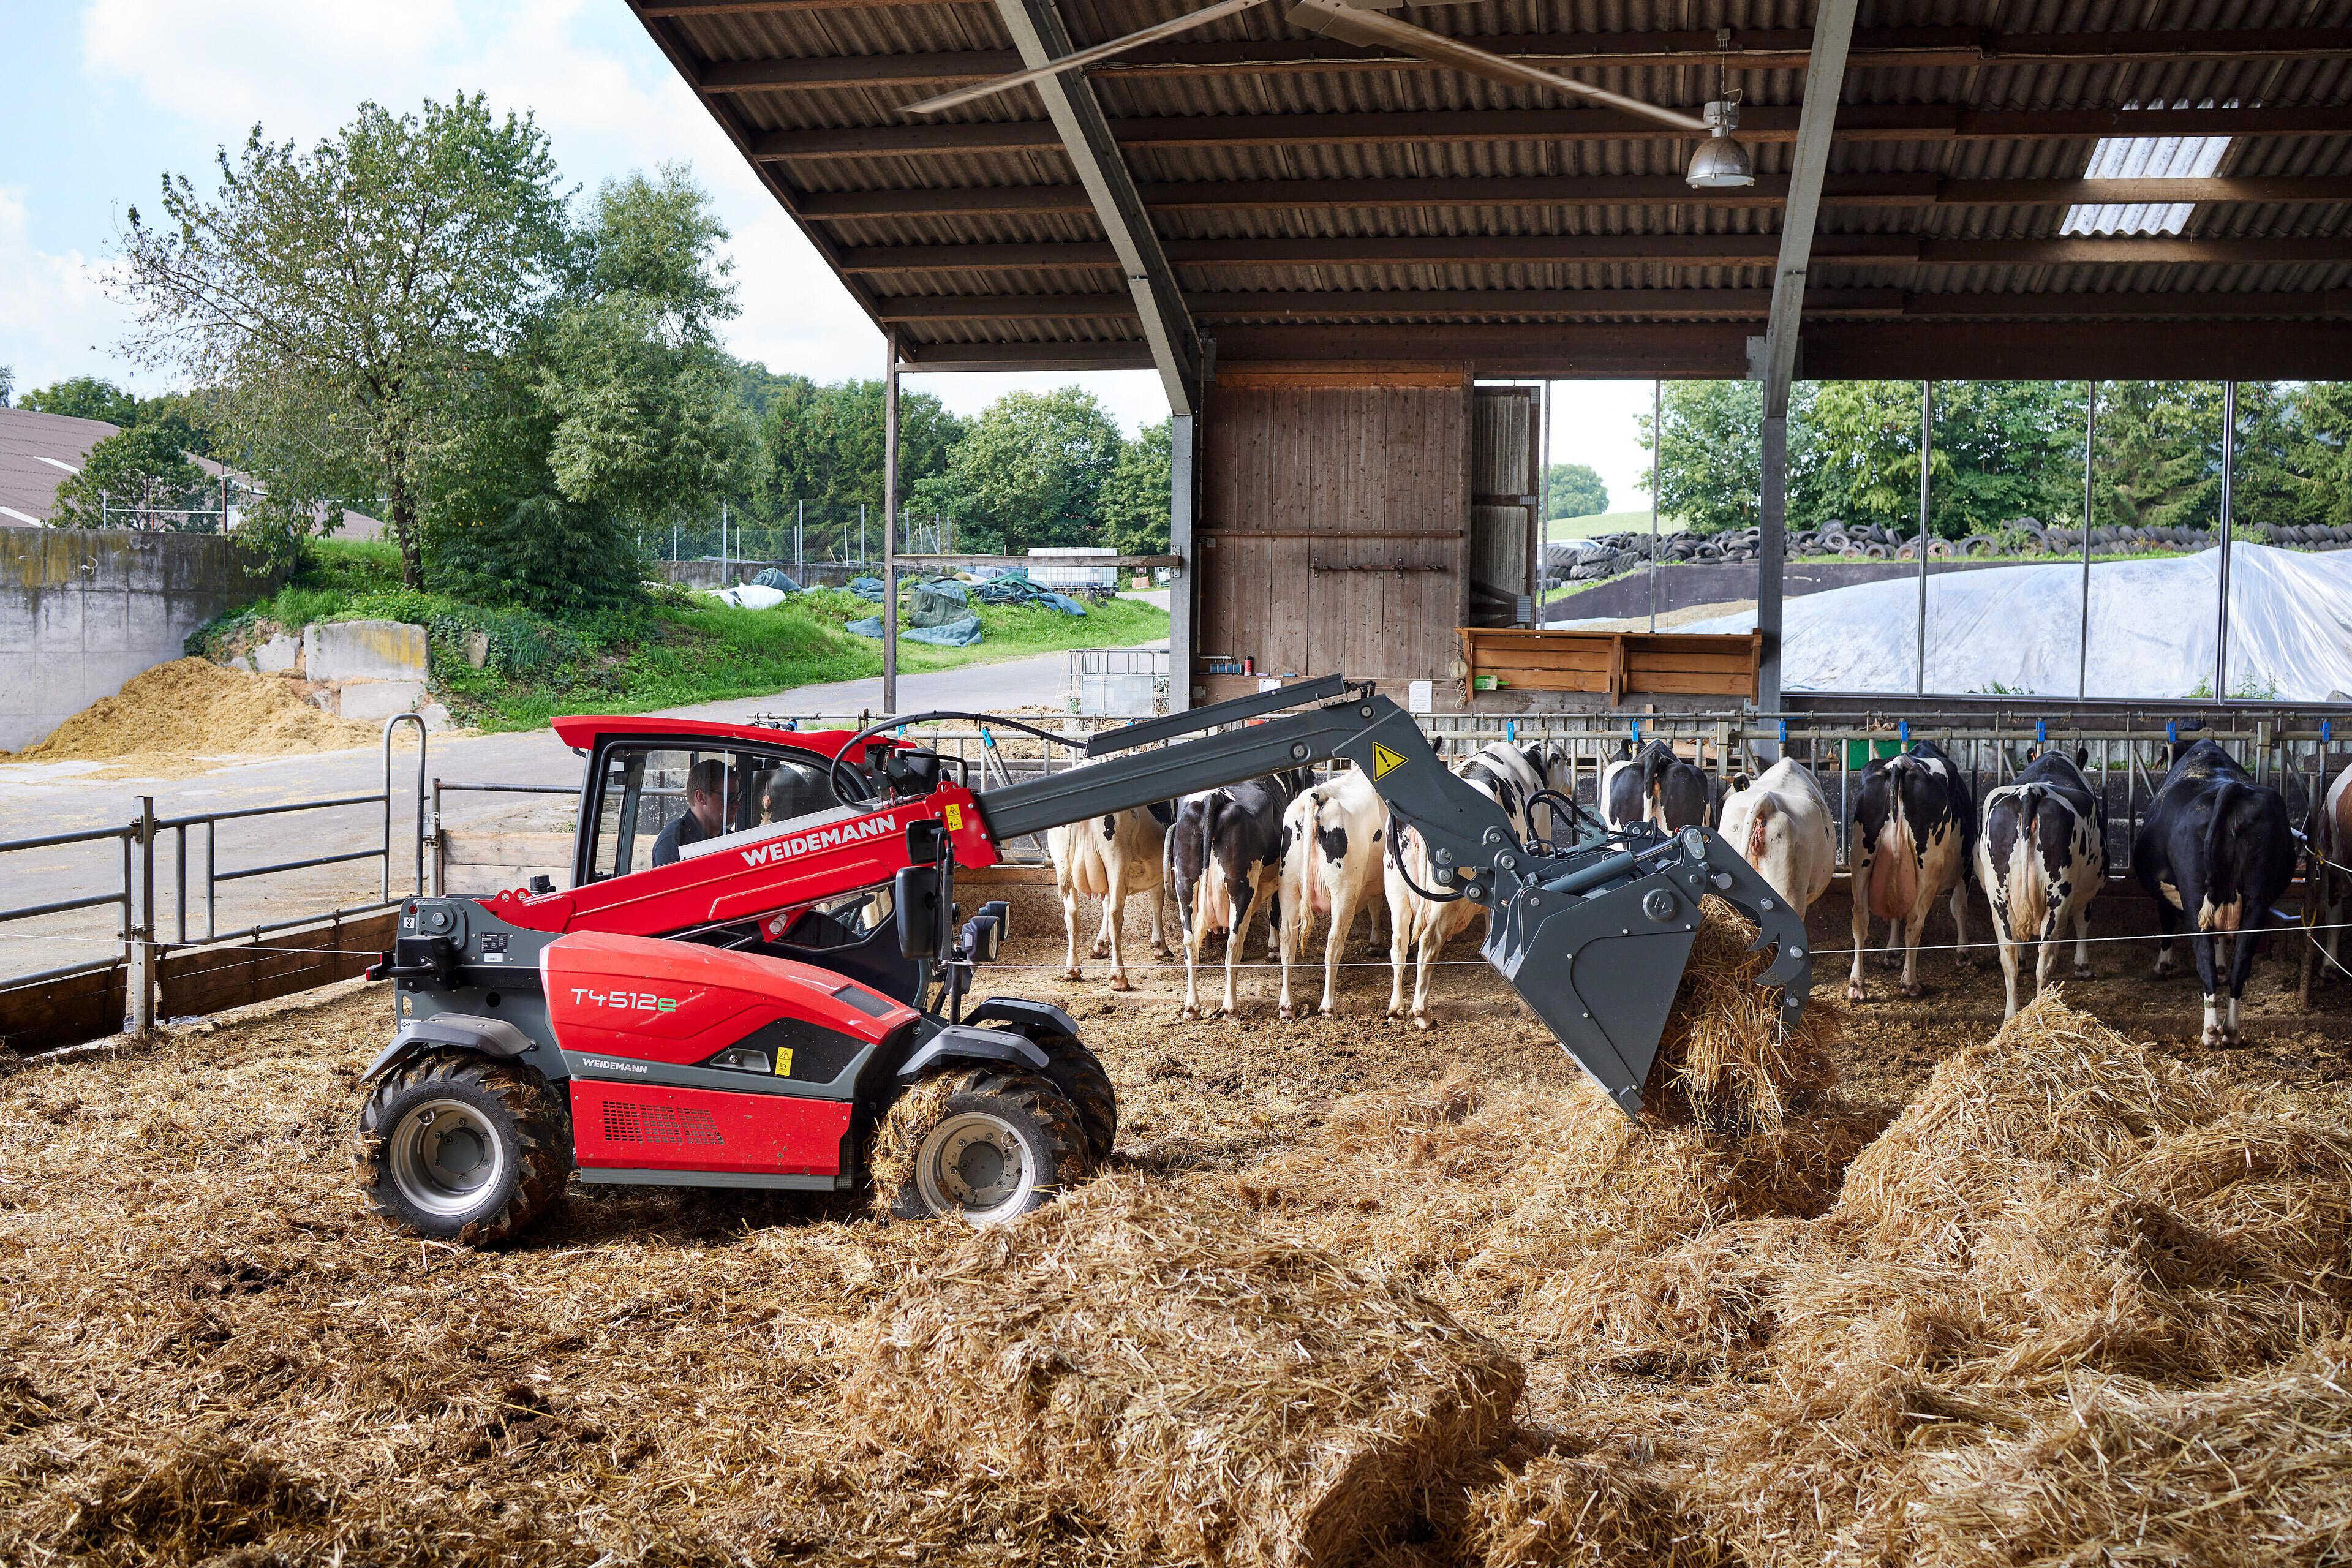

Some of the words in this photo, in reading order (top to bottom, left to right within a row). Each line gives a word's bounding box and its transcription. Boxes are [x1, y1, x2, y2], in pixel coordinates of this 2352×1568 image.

[740, 814, 897, 867] WEIDEMANN
[571, 988, 677, 1012] T4512e
[582, 1058, 648, 1074] WEIDEMANN
